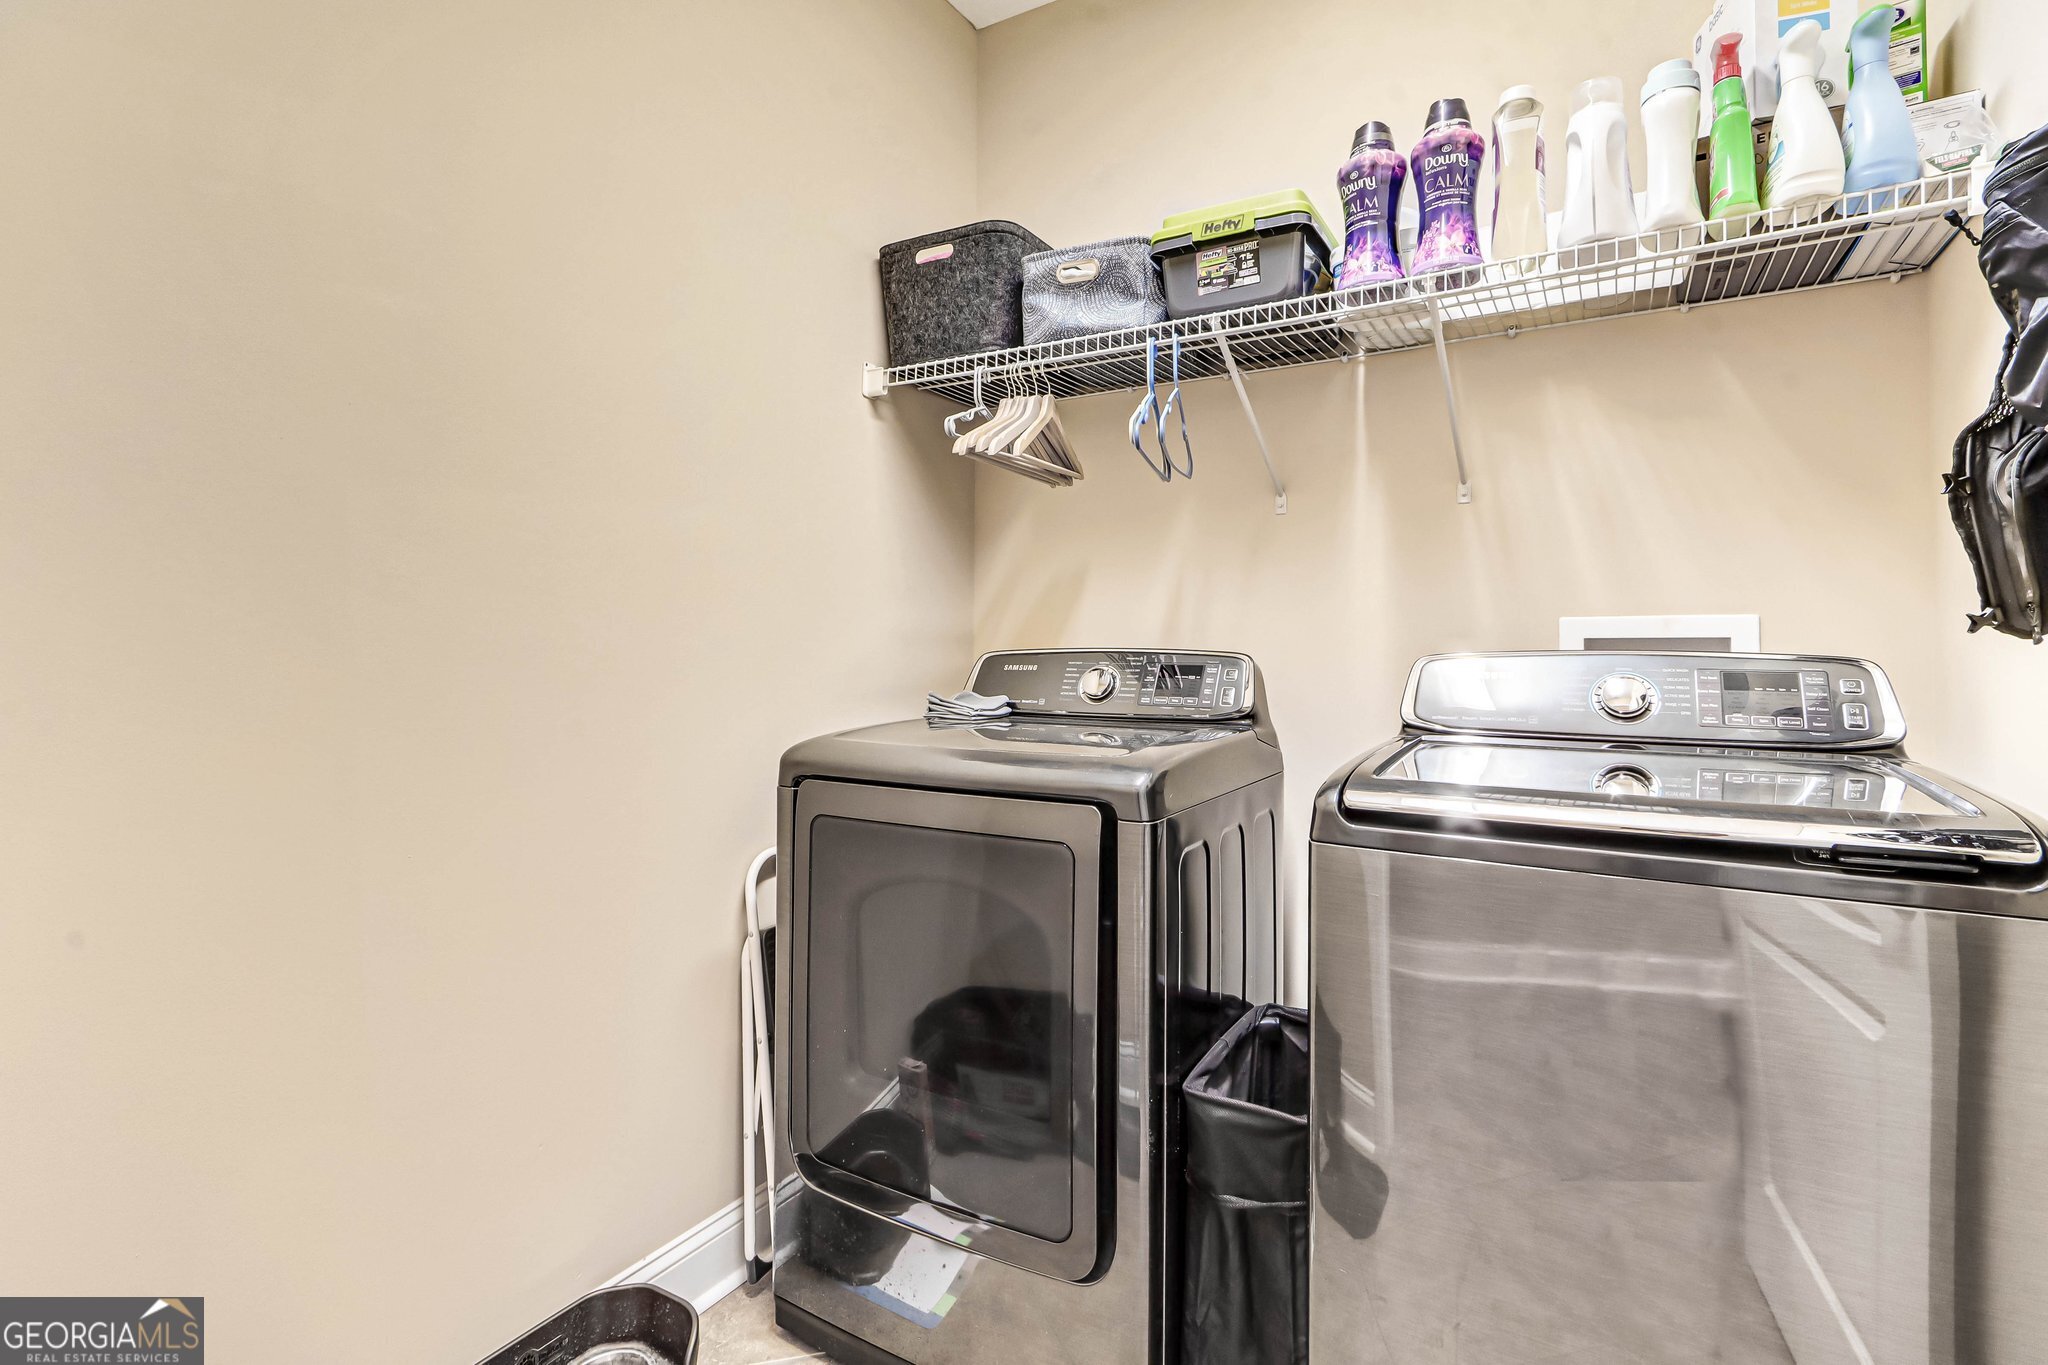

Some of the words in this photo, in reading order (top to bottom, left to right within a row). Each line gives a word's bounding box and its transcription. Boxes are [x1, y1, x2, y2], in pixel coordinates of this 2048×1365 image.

[1424, 152, 1469, 171] Downy
[1341, 175, 1376, 199] Downy
[1424, 172, 1469, 194] CALM
[1344, 195, 1379, 220] CALM
[1203, 218, 1242, 235] Hefty
[1202, 250, 1222, 260] Hefty
